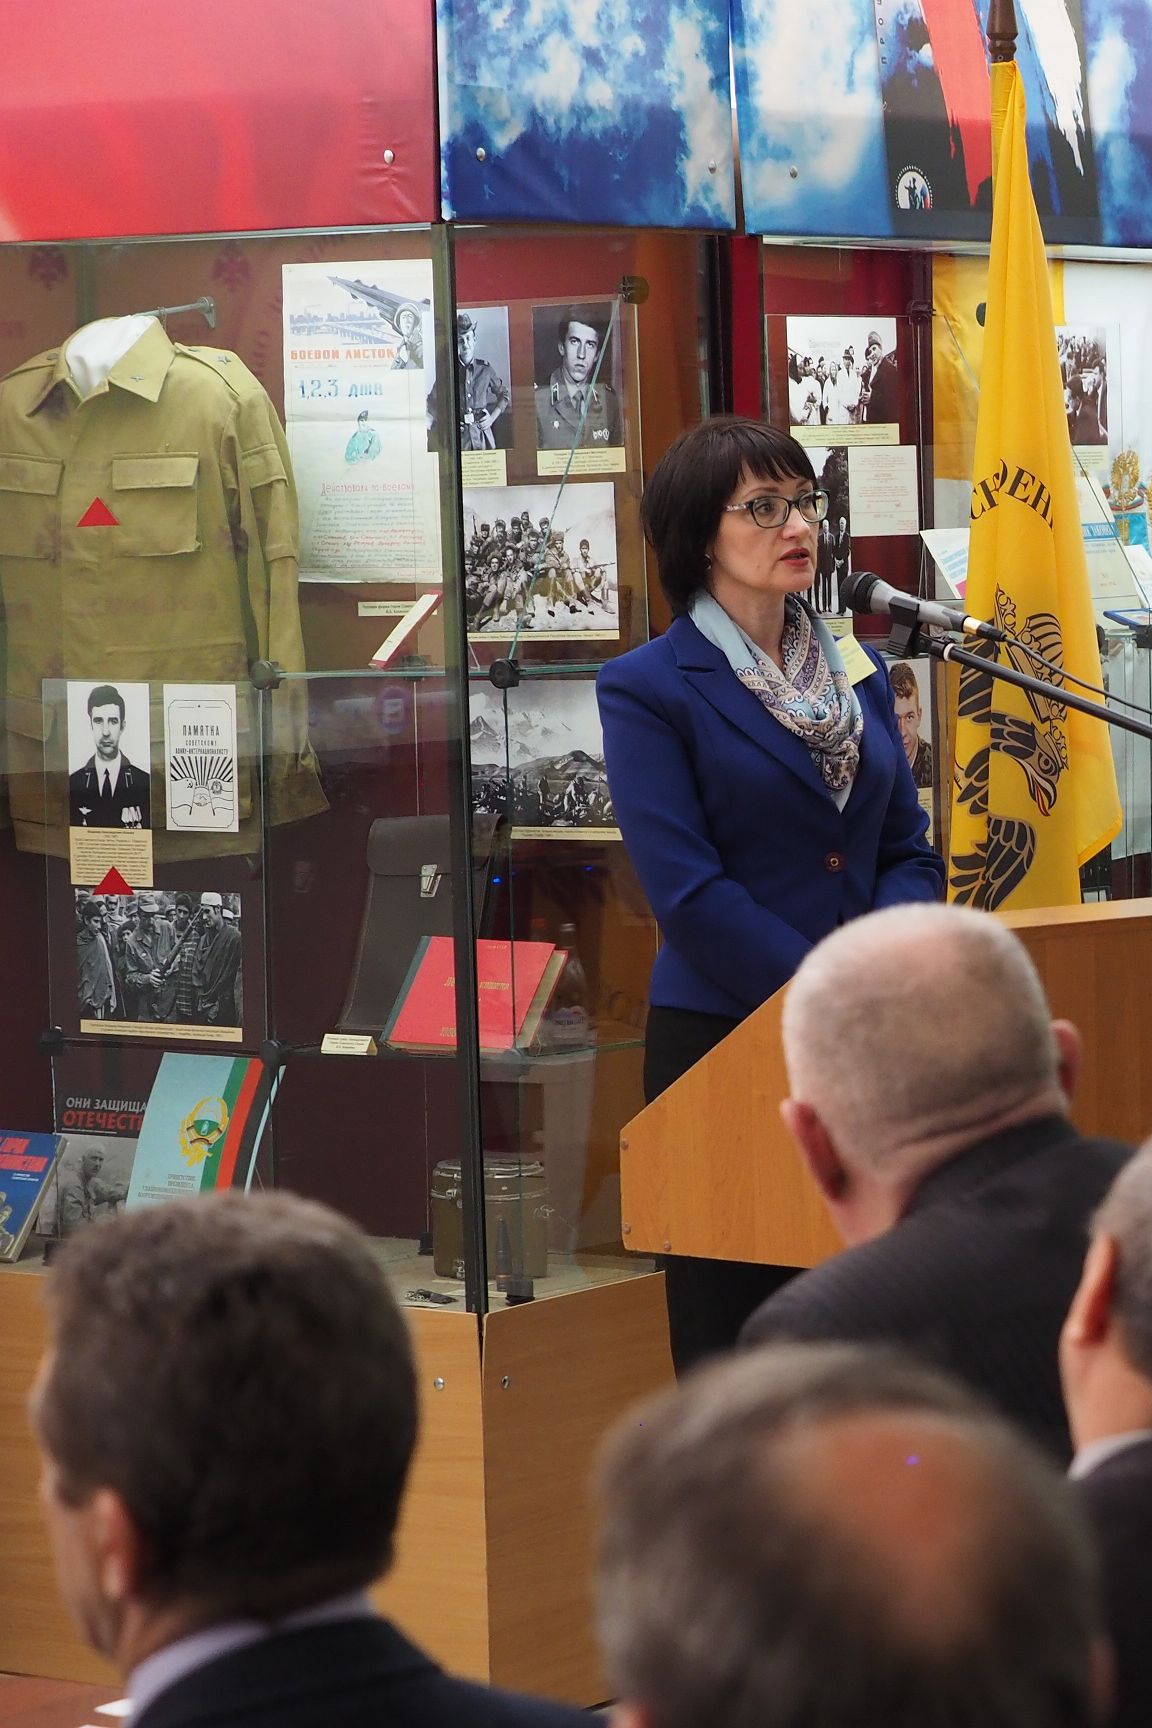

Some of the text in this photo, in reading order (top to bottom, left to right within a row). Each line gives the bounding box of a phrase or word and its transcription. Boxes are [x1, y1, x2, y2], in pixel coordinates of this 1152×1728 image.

[290, 348, 396, 360] БОЕВОЙ ЛИСТОК
[183, 725, 220, 736] ПАМЯТКА
[65, 1096, 91, 1109] ОНИ
